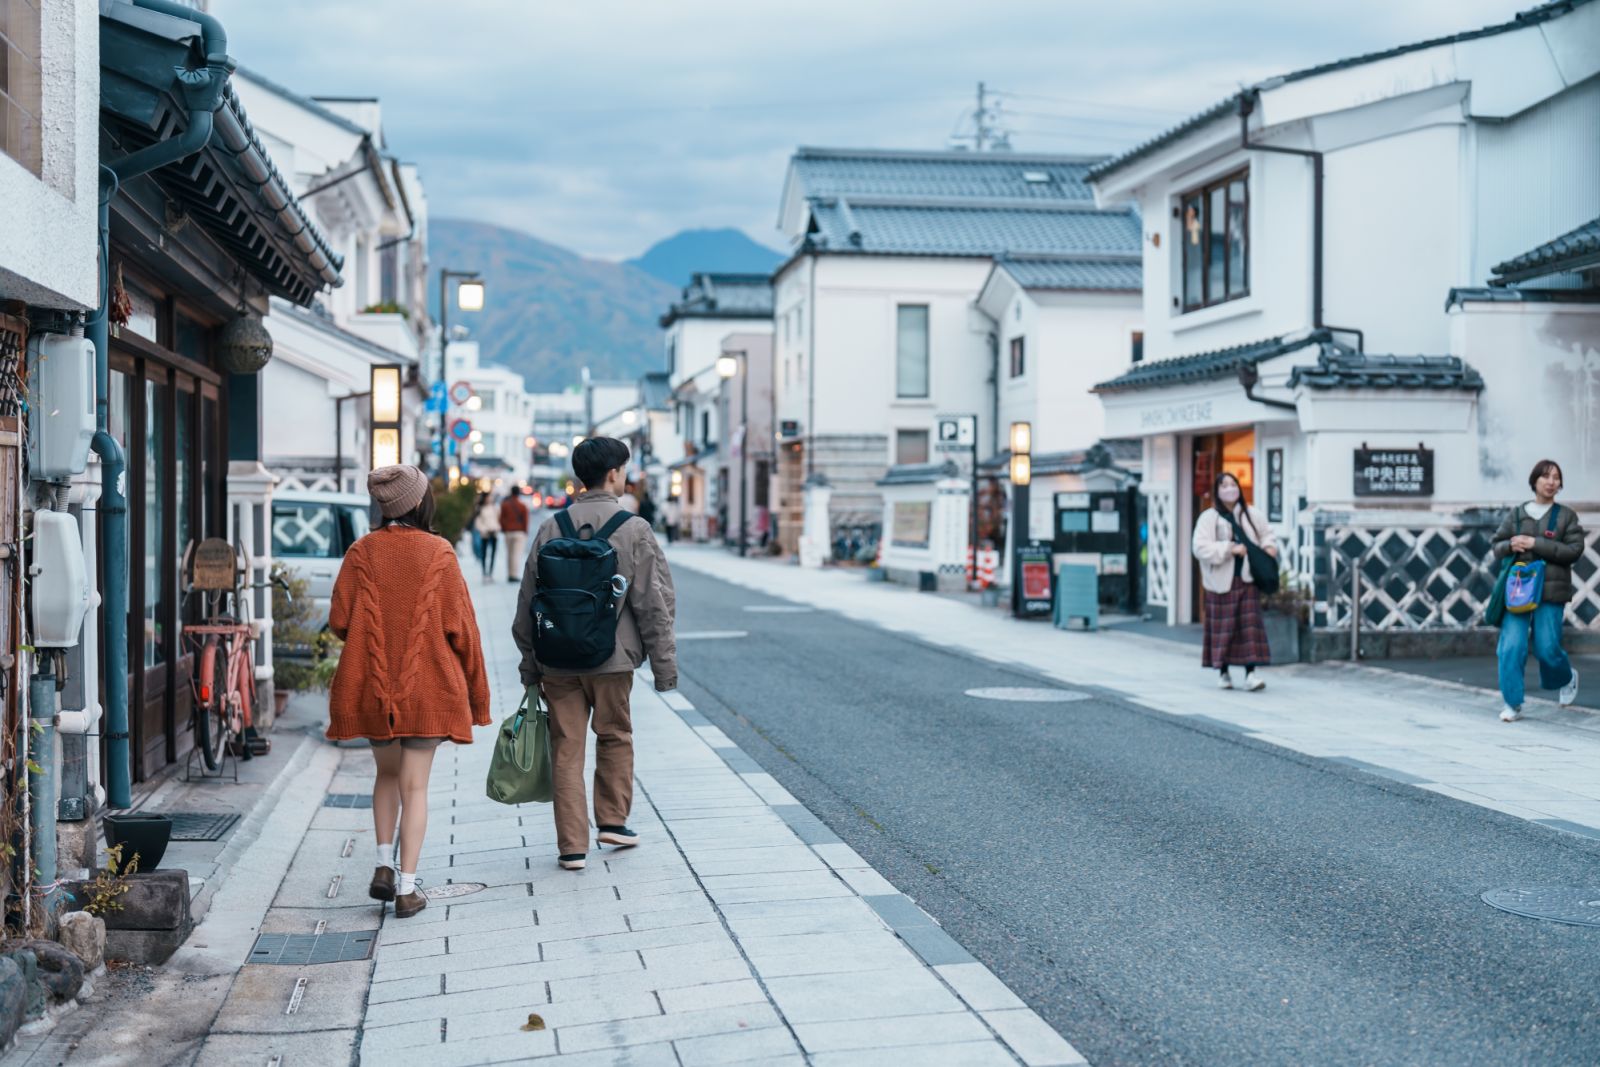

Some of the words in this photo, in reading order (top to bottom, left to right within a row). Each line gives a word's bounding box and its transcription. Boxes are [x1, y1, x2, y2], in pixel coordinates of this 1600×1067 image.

[942, 422, 956, 439] P
[1364, 465, 1424, 482] 中央民芸
